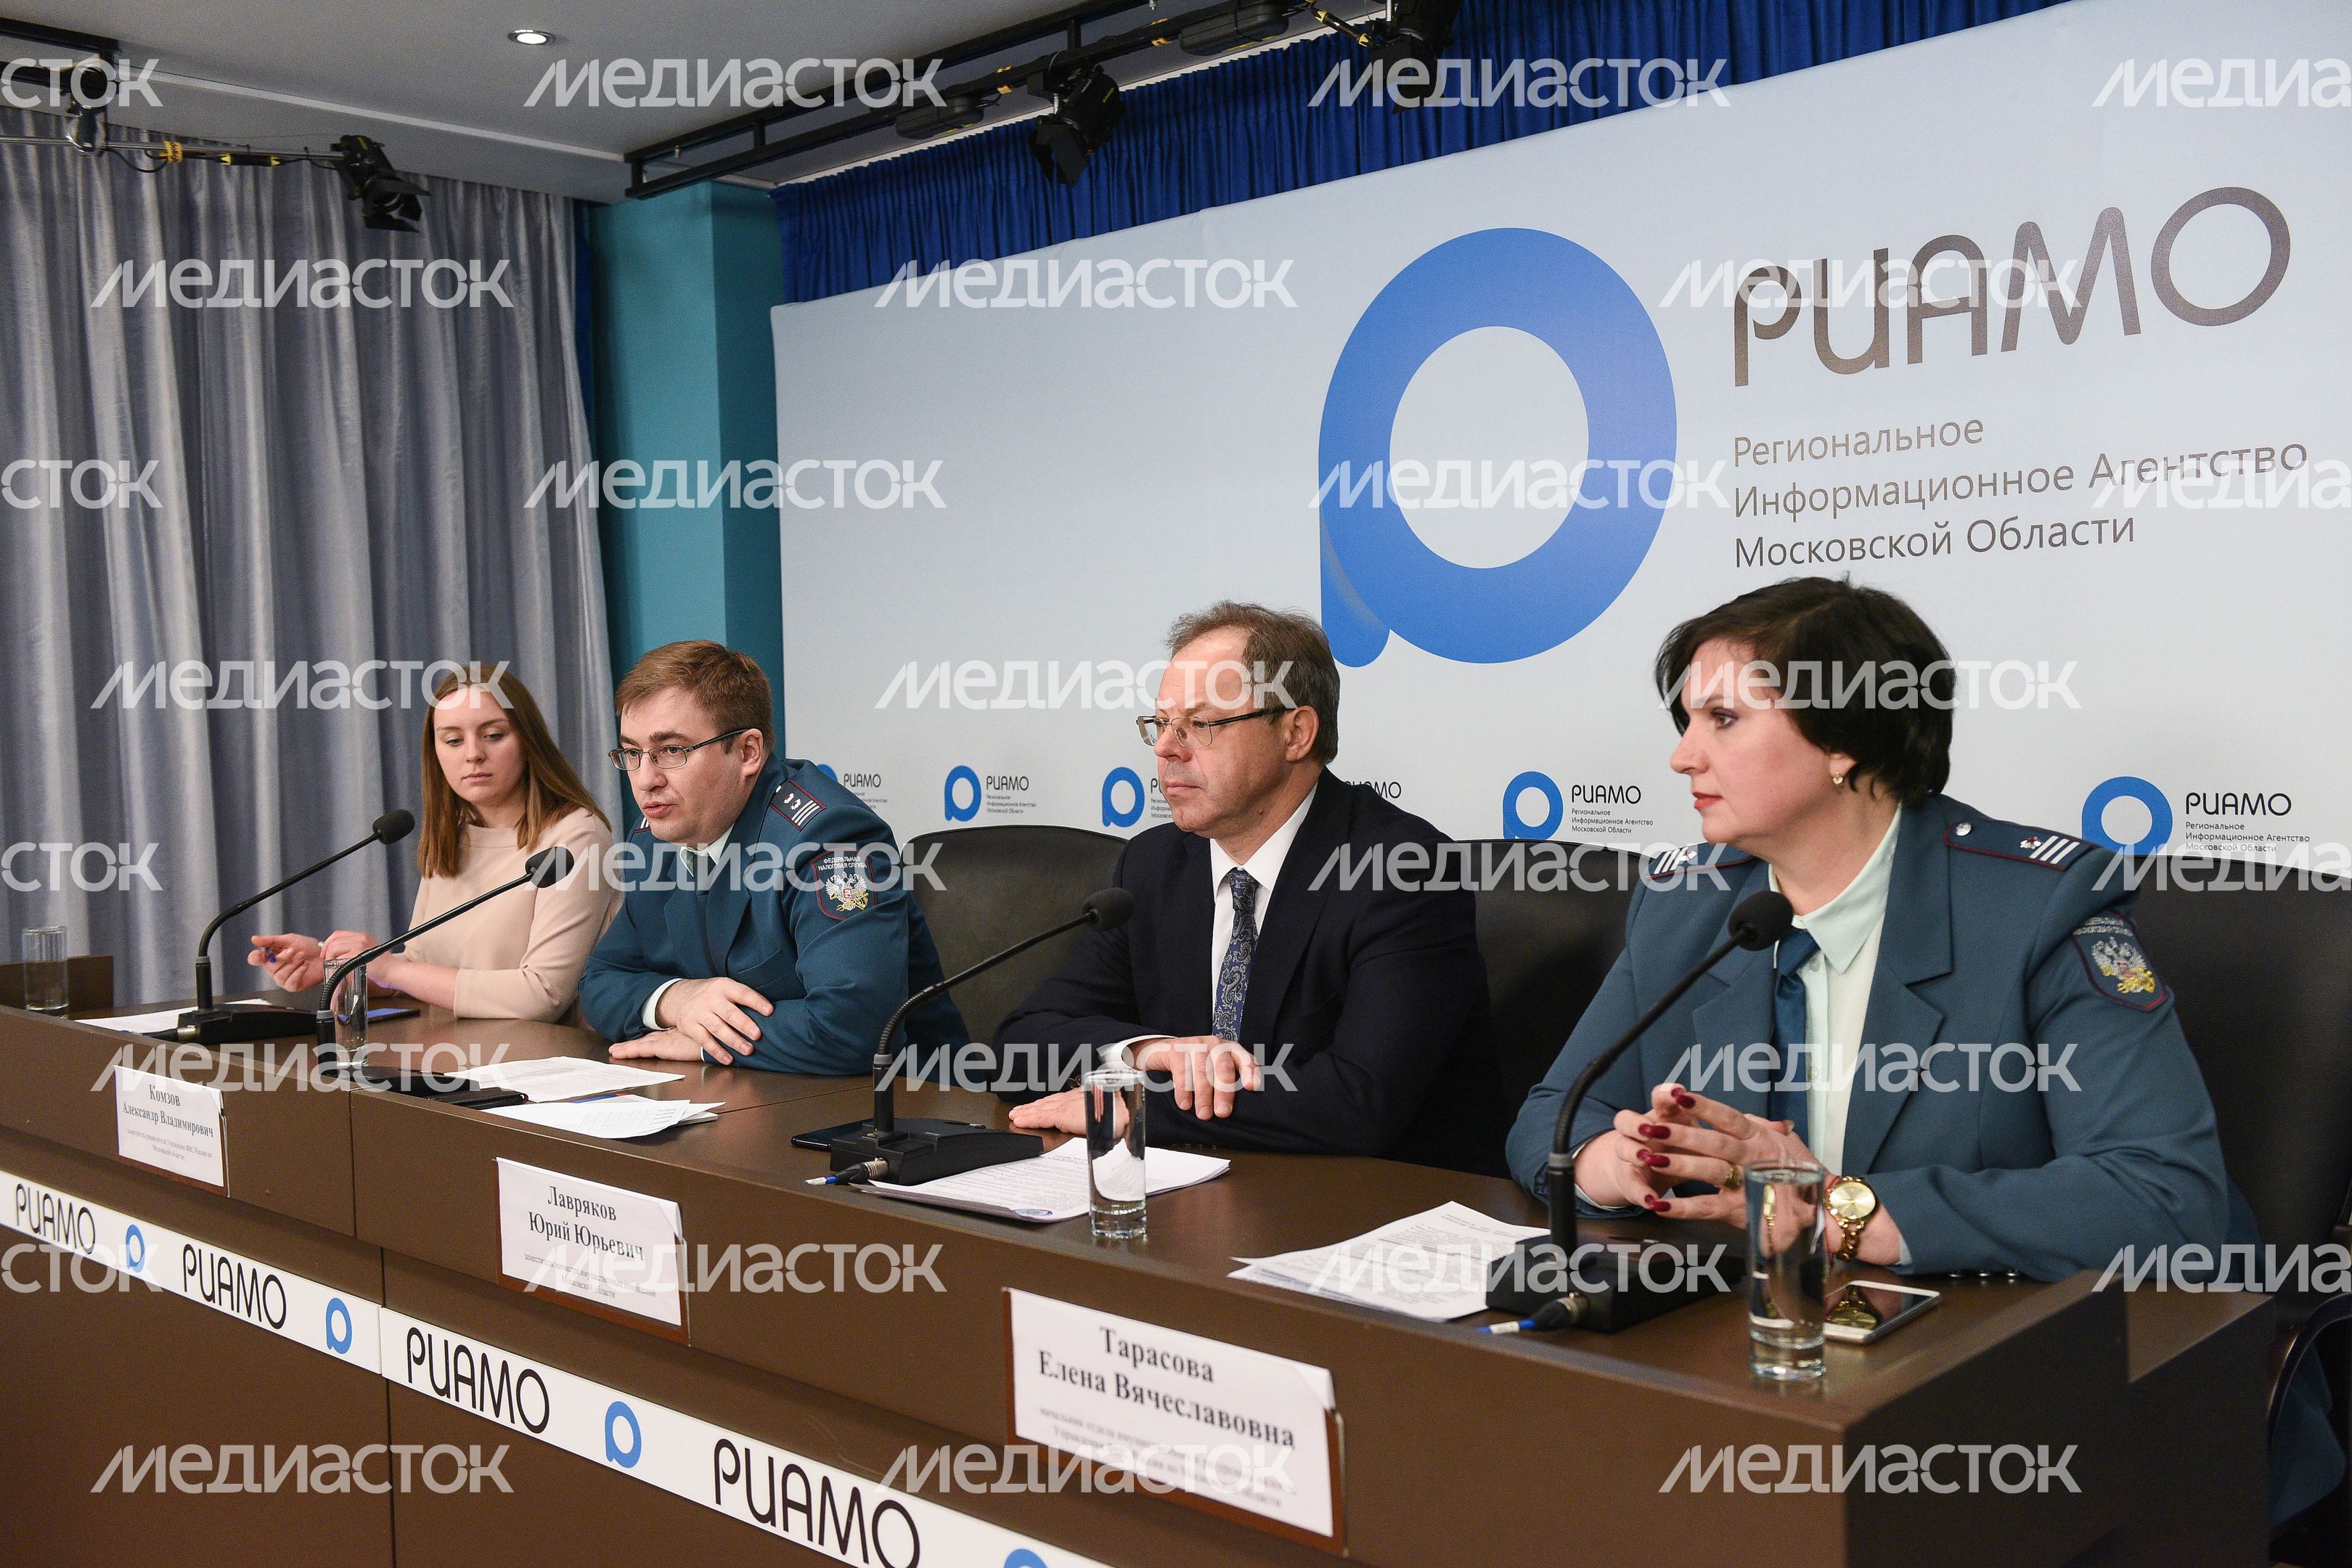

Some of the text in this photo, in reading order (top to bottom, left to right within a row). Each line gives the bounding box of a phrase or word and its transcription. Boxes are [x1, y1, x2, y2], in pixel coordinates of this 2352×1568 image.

[1734, 187, 2291, 388] РИАМО
[1735, 416, 1984, 467] Региональное
[1735, 443, 2307, 523] Информационное Агентство
[1735, 515, 2135, 569] Московской Области
[844, 774, 881, 788] РИАМО
[986, 775, 1029, 791] РИАМО
[1572, 785, 1641, 804] РИАМО
[2186, 792, 2292, 816] РИАМО
[2186, 822, 2245, 830] Региональное
[2186, 833, 2264, 842] Информационное
[2186, 842, 2277, 852] Московской Области
[818, 862, 848, 871] НАЛОГОВАЯ
[149, 1084, 181, 1107] Комзов
[123, 1103, 213, 1138] Александр Владимирович
[15, 1183, 97, 1255] РИАМО
[547, 1185, 616, 1221] Лавряков
[528, 1211, 644, 1261] Юрий Юрьевич
[182, 1244, 287, 1330] РИАМО
[1100, 1326, 1214, 1383] Тарасова
[407, 1326, 550, 1434] РИАМО
[1039, 1349, 1295, 1448] Елена Вячеславовна
[714, 1438, 921, 1568] РИАМО
